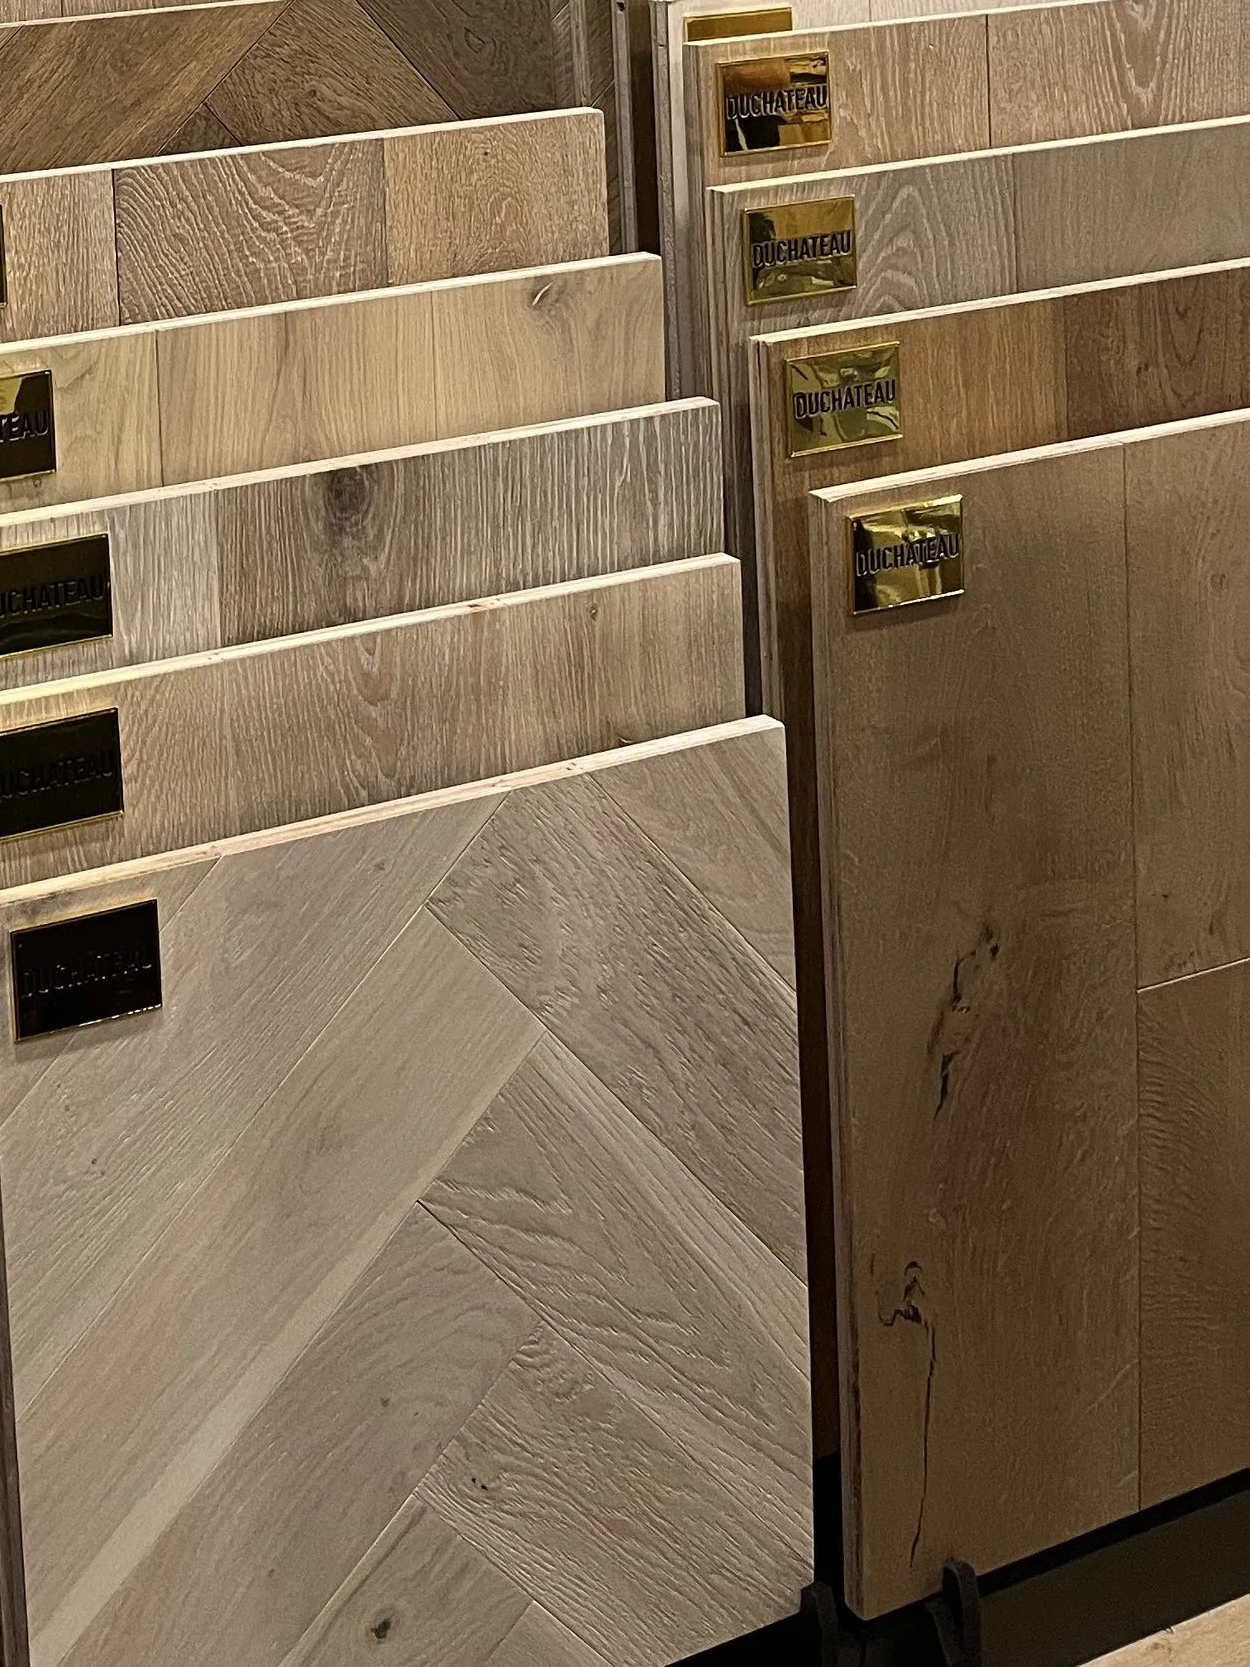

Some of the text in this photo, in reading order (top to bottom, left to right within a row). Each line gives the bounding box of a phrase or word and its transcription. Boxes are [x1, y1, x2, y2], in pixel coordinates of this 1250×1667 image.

[726, 84, 828, 119] DUCHATEAU
[752, 230, 851, 267] DUCHATEAU
[793, 379, 896, 420] DUCHATEAU
[856, 533, 959, 576] DUCHATEAU
